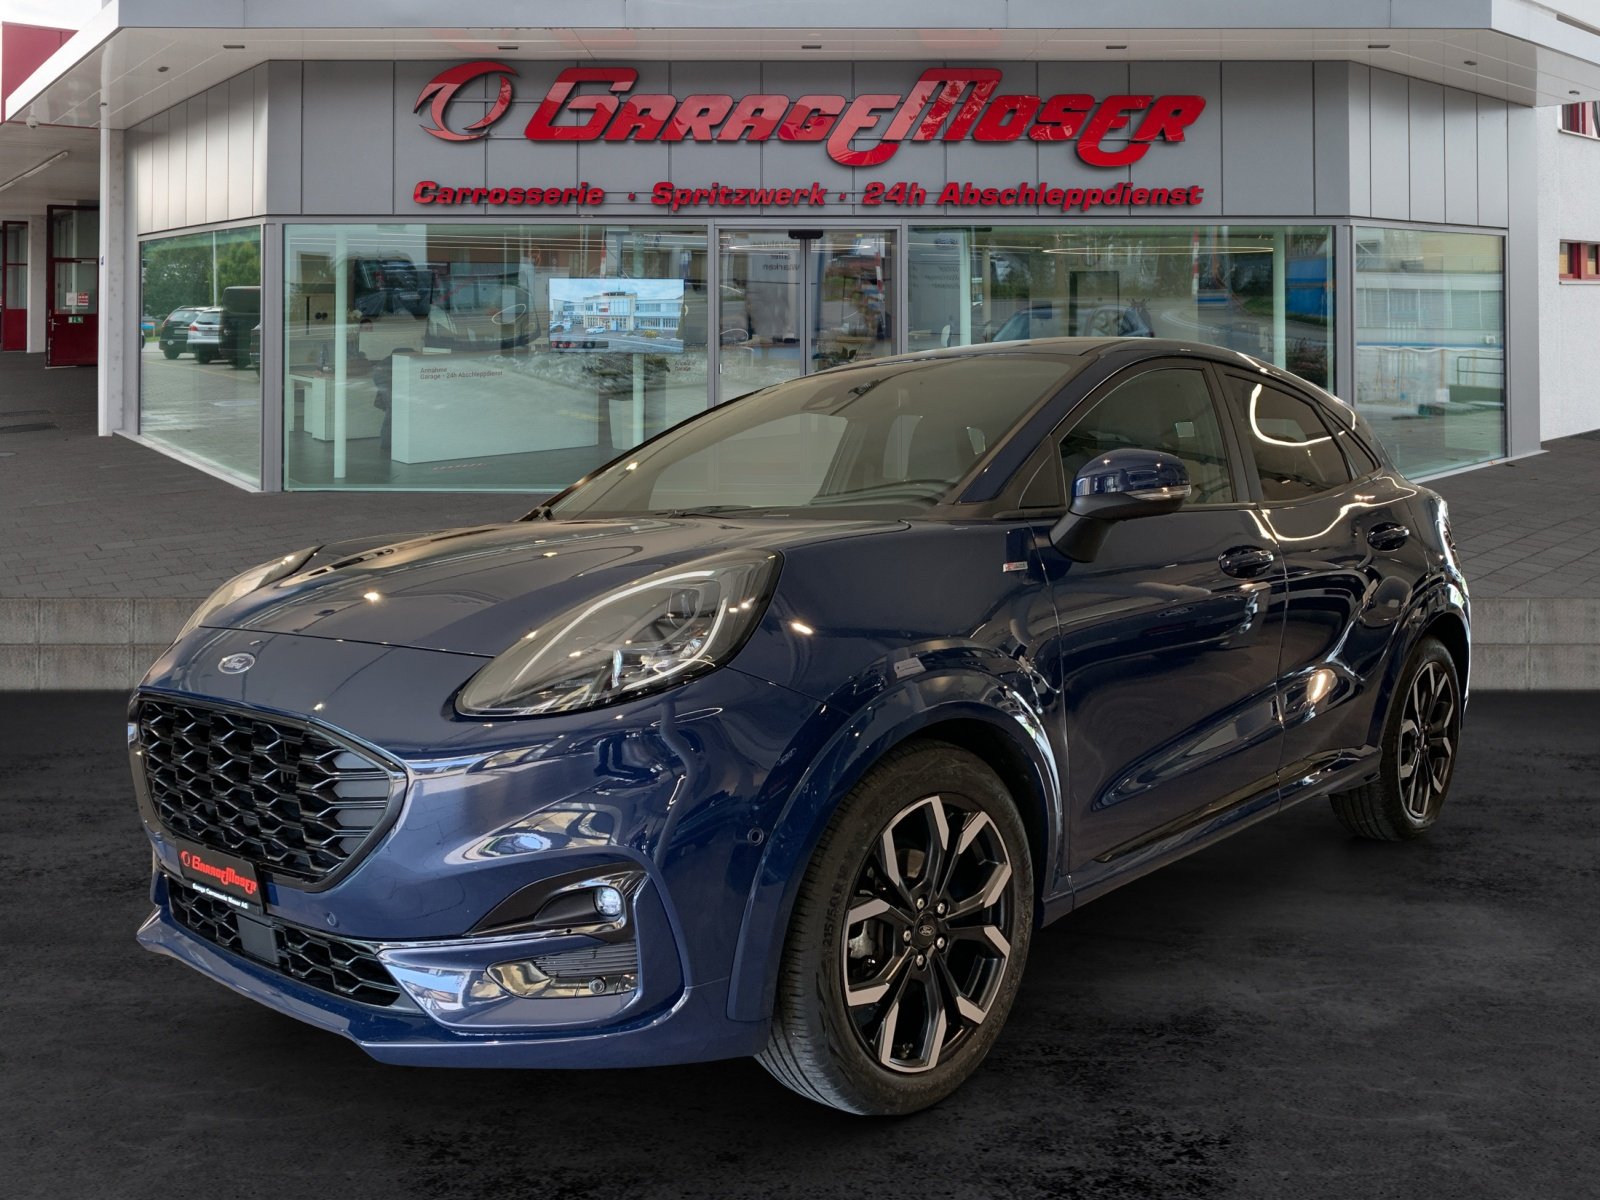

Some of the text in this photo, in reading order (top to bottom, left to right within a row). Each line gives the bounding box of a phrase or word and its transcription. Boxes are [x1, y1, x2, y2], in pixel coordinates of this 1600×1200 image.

[413, 181, 1204, 211] Carrosserie Spritzwerk 24h Abschleppdienst
[458, 370, 503, 378] Abschleppdienst
